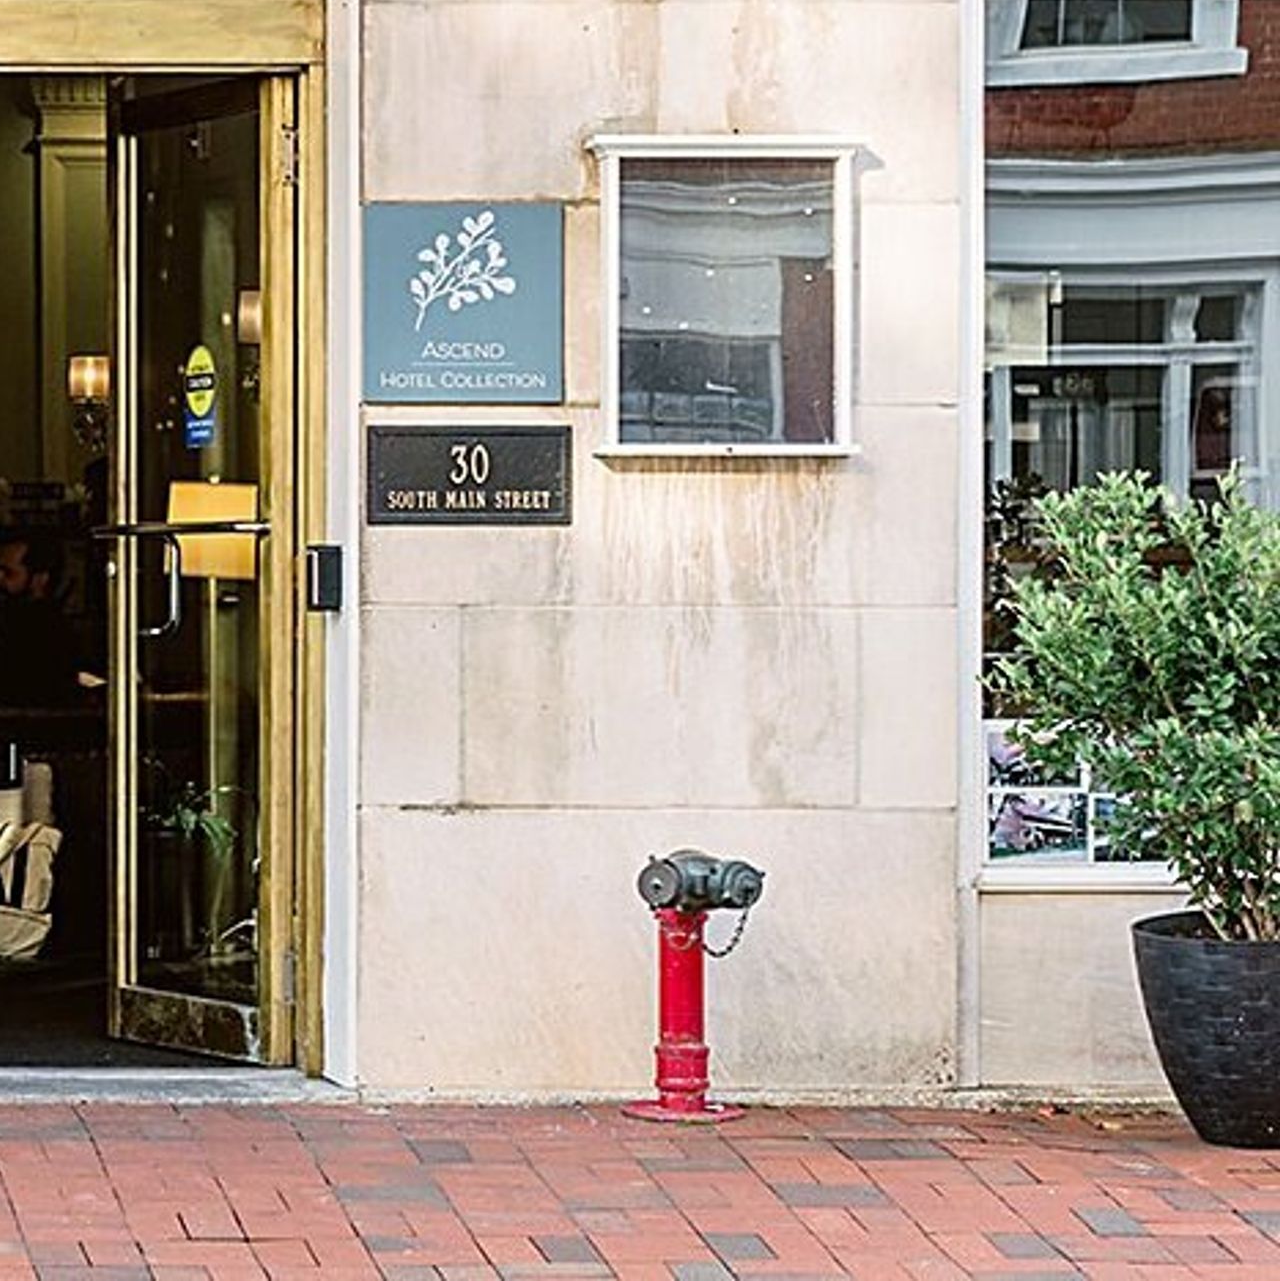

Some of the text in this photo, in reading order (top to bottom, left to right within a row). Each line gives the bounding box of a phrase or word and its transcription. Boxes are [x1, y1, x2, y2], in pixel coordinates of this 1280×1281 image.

[420, 341, 505, 360] ASCEND
[380, 372, 547, 389] HOTEL COLLECTION
[450, 443, 490, 485] 30
[388, 490, 552, 510] SOUTH MAIN STREET
